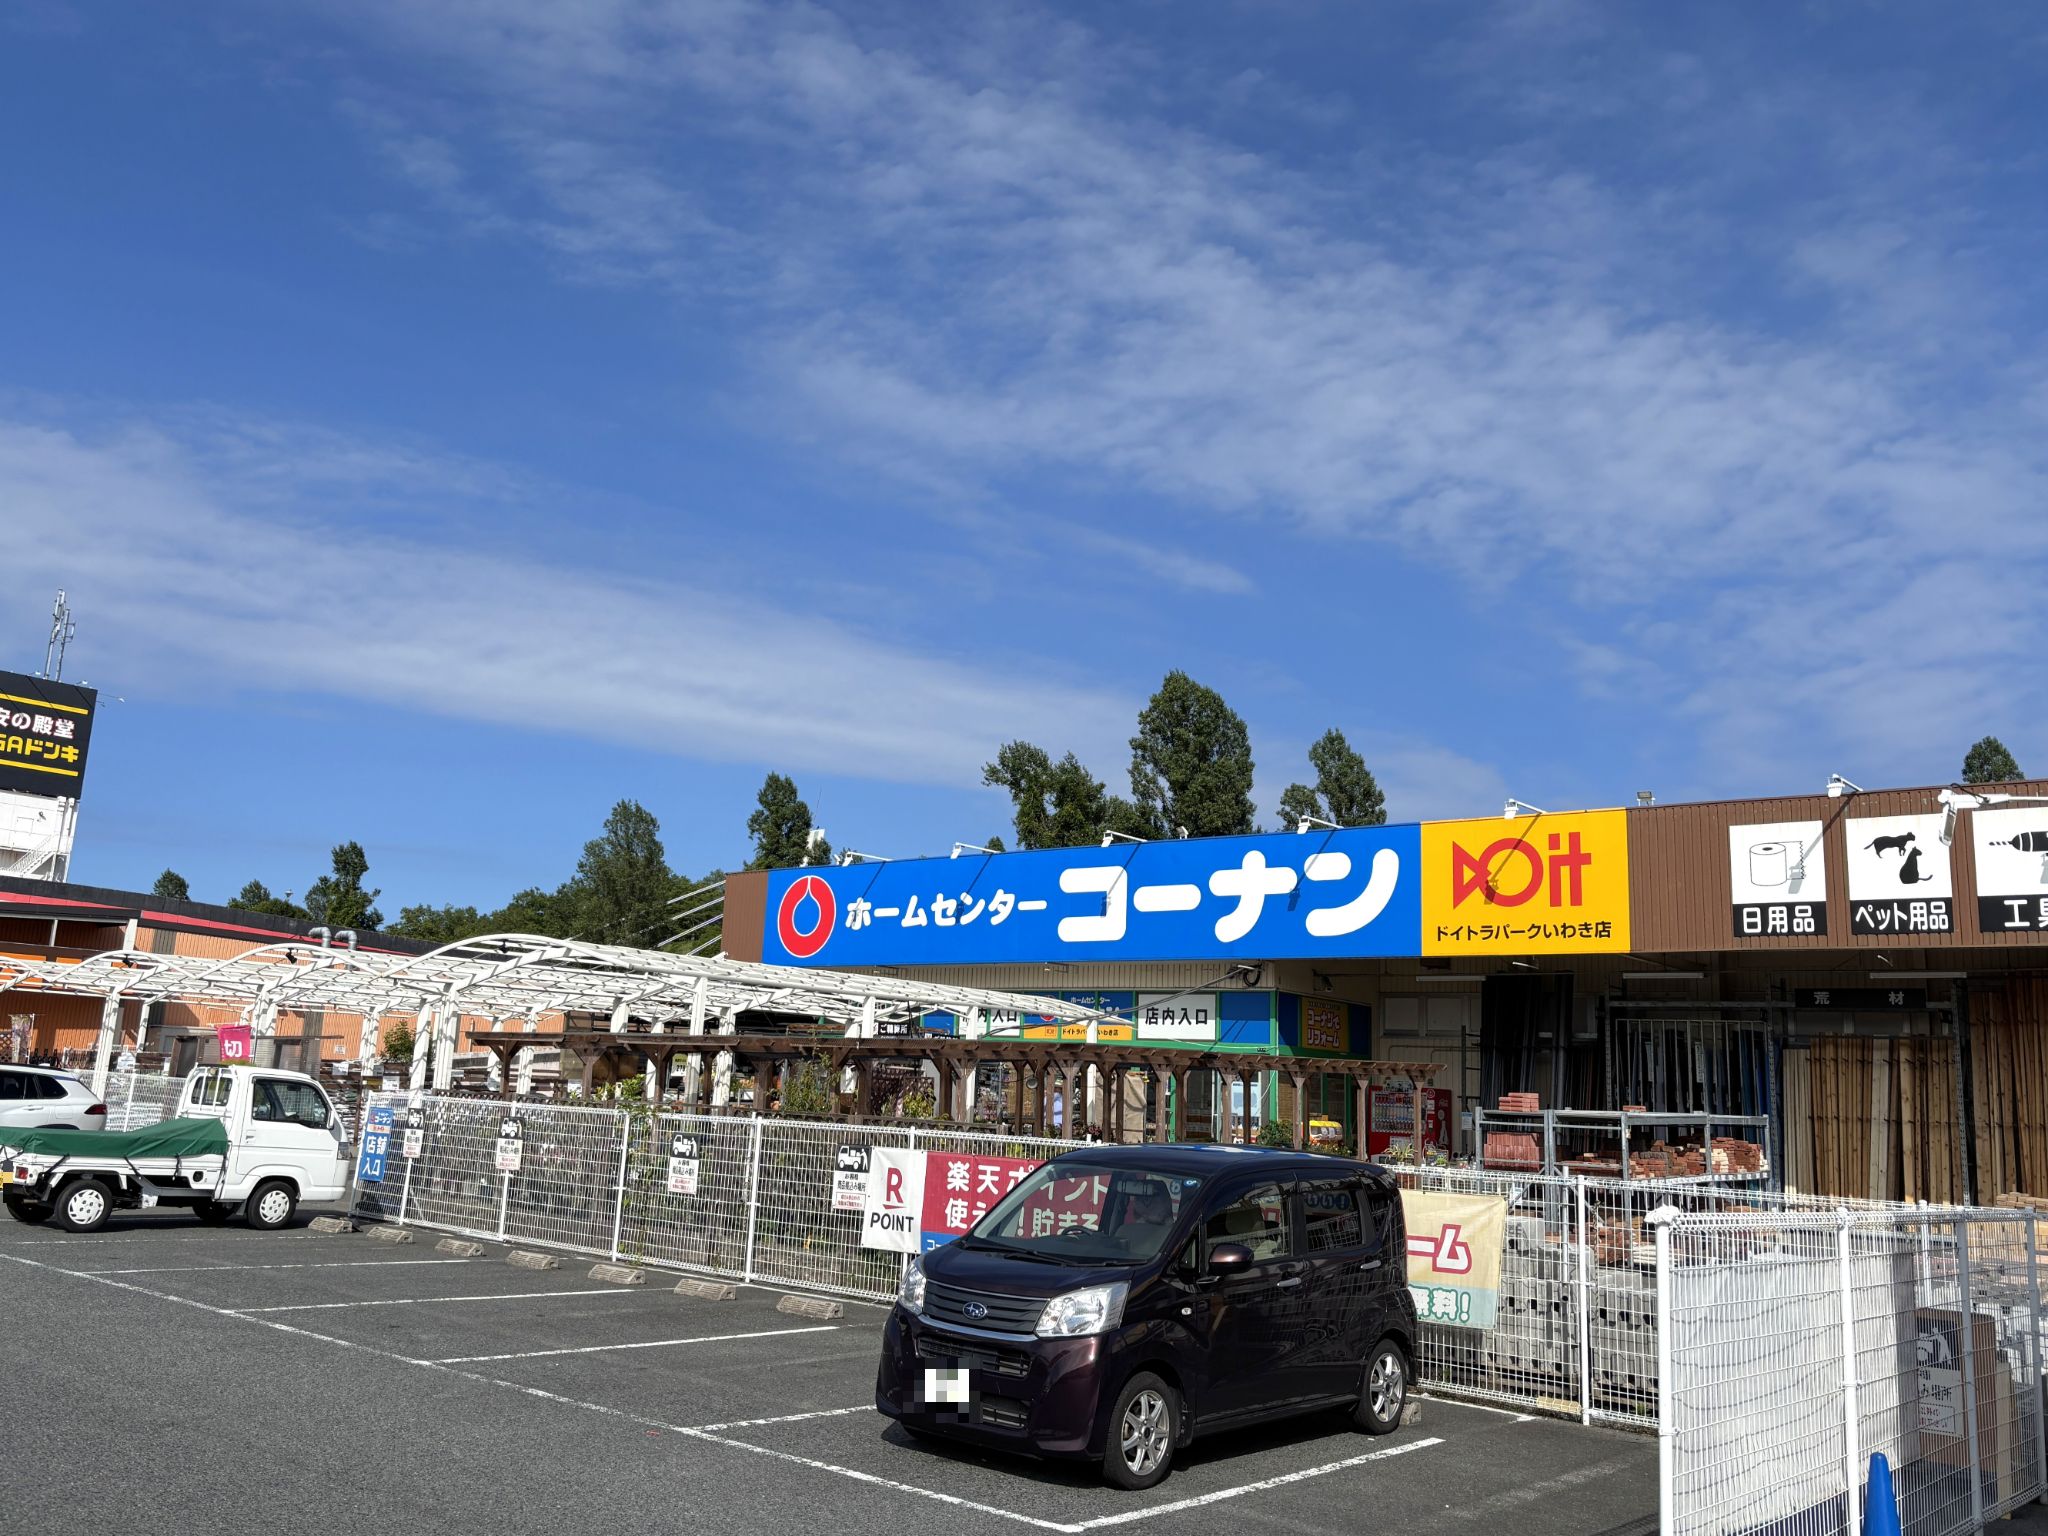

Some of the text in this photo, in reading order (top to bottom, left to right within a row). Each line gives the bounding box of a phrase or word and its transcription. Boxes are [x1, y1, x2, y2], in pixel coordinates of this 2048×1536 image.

[845, 848, 1400, 943] ホームセンター コーナン
[1742, 905, 1815, 934] 日用品
[1855, 901, 1949, 931] ペット用品
[1437, 921, 1612, 942] ドイトラパークいわき店
[1145, 1007, 1208, 1026] 店内入口
[366, 1135, 387, 1154] 店舗
[362, 1157, 381, 1176] 入口
[870, 1212, 914, 1232] POINT
